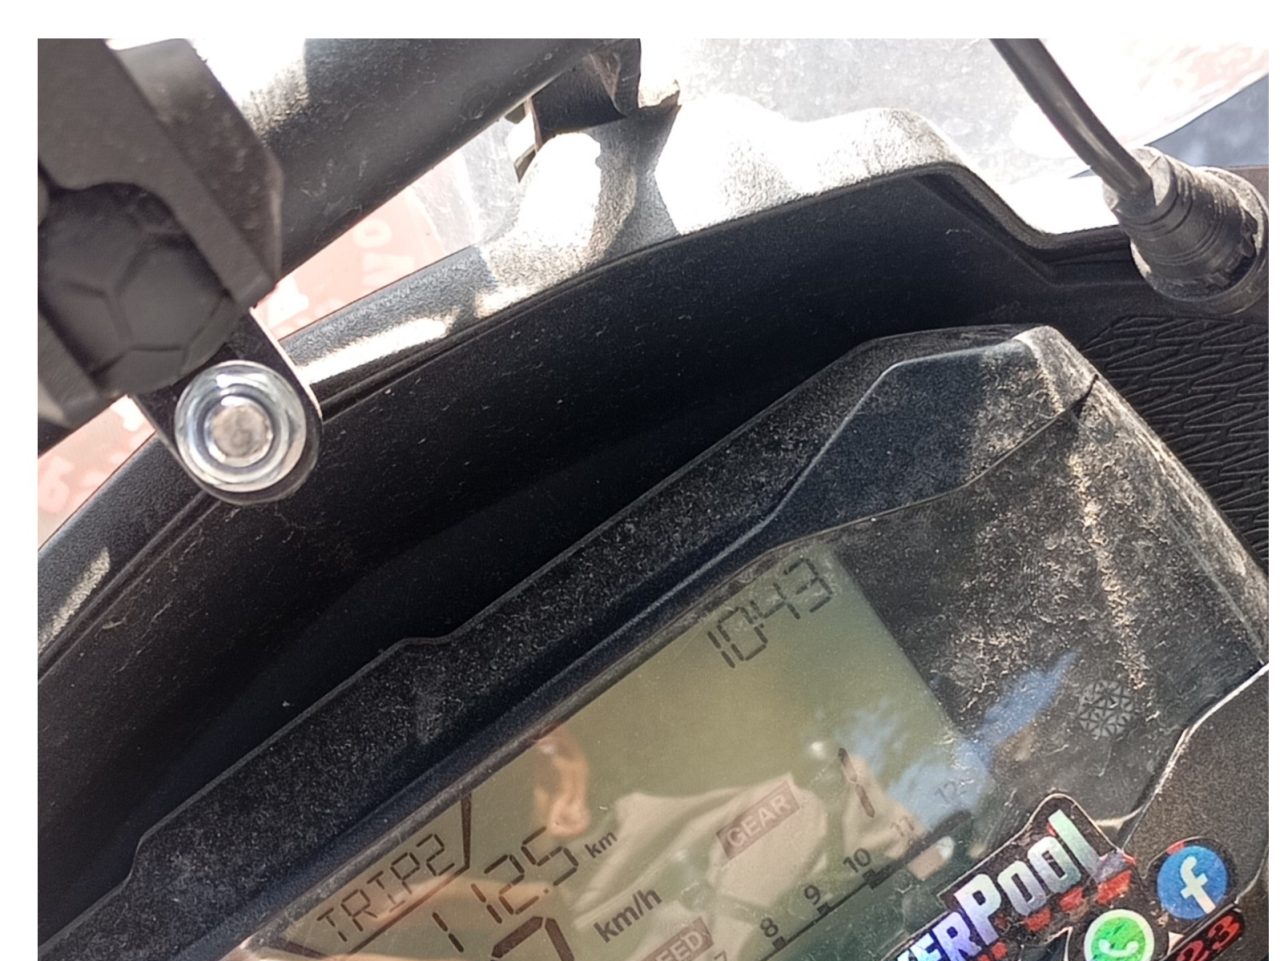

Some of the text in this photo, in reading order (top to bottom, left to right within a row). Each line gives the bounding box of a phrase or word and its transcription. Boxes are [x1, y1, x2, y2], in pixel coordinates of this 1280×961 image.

[584, 830, 618, 860] km
[725, 794, 792, 847] GEAR
[316, 833, 455, 943] TRIP2
[593, 888, 663, 943] km/h
[759, 917, 779, 938] 8
[804, 884, 821, 906] 9
[842, 847, 871, 874] 10
